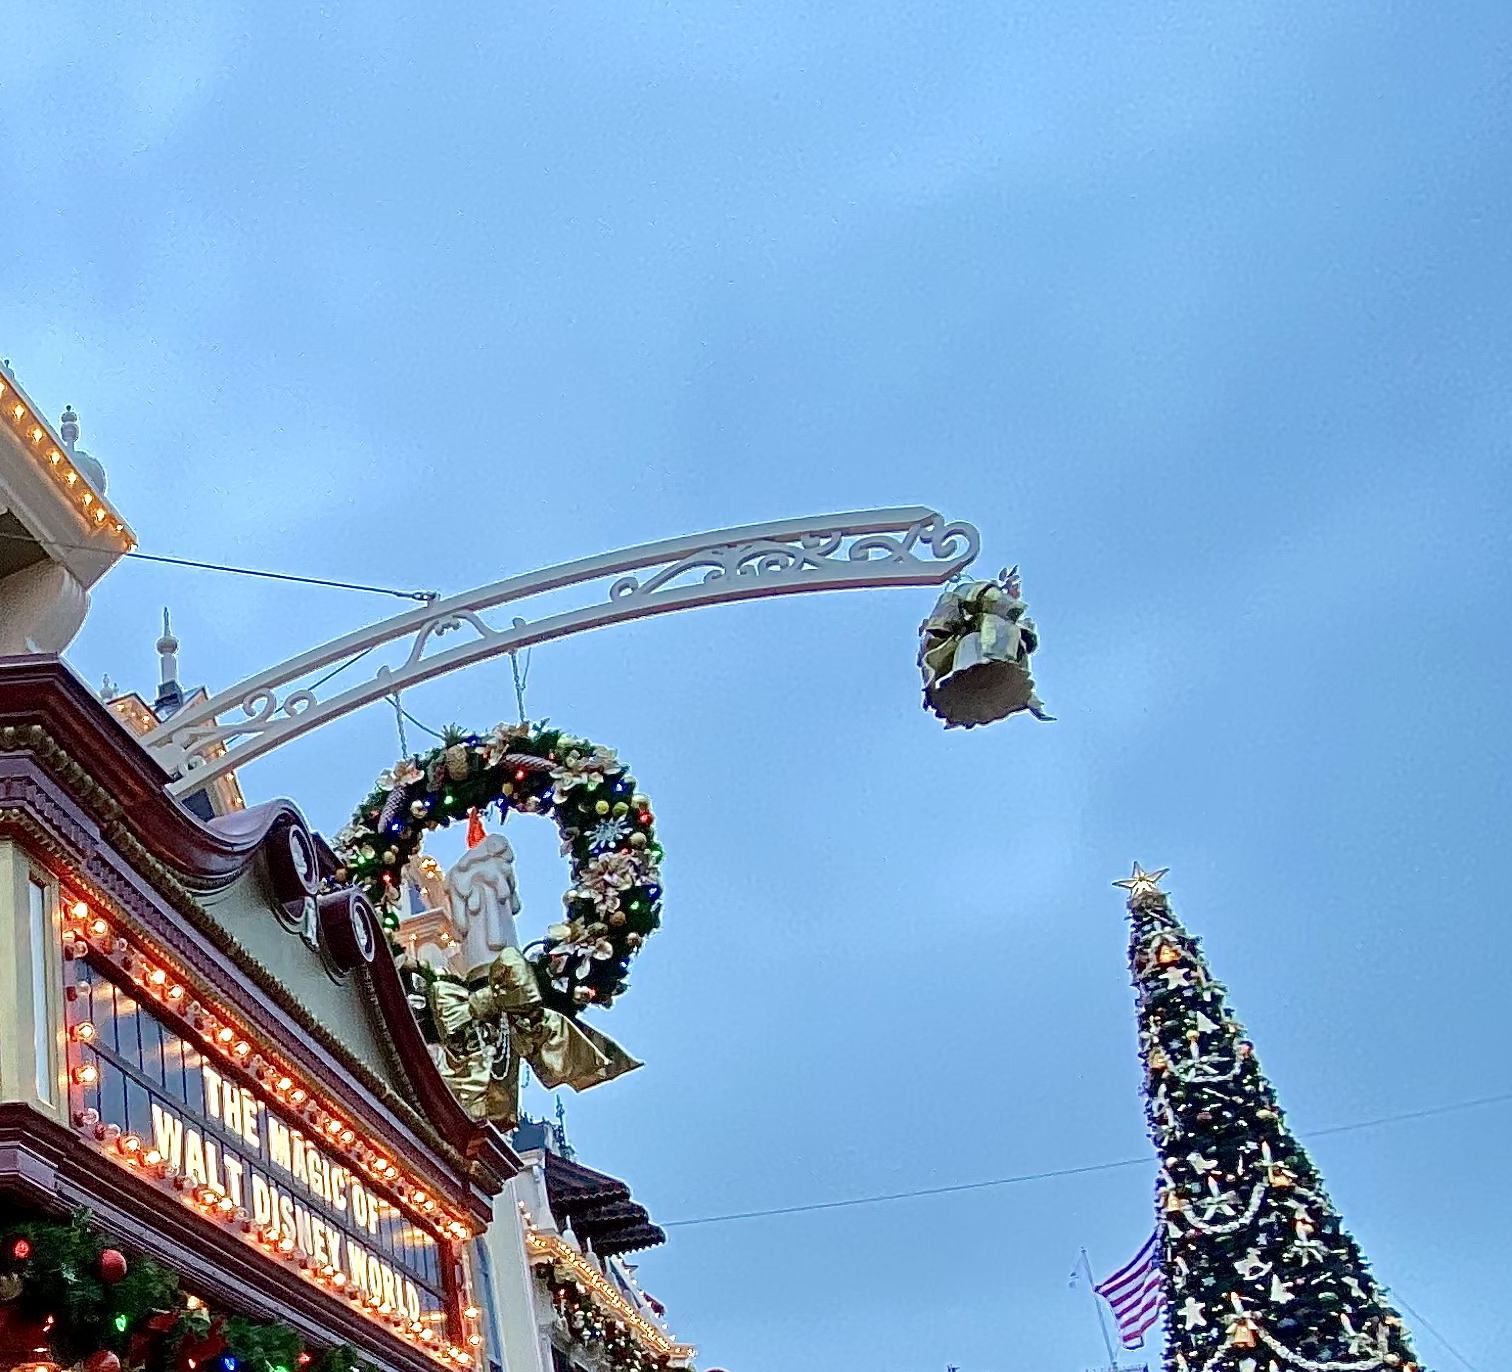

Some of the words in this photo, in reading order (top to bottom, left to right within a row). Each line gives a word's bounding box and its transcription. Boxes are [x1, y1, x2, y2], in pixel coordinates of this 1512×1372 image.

[153, 1106, 243, 1208] WALT
[252, 1173, 341, 1271] DISNEY
[347, 1241, 420, 1323] WORLD
[203, 1065, 260, 1149] THE
[270, 1118, 347, 1210] MAGIC
[352, 1180, 379, 1234] OF
